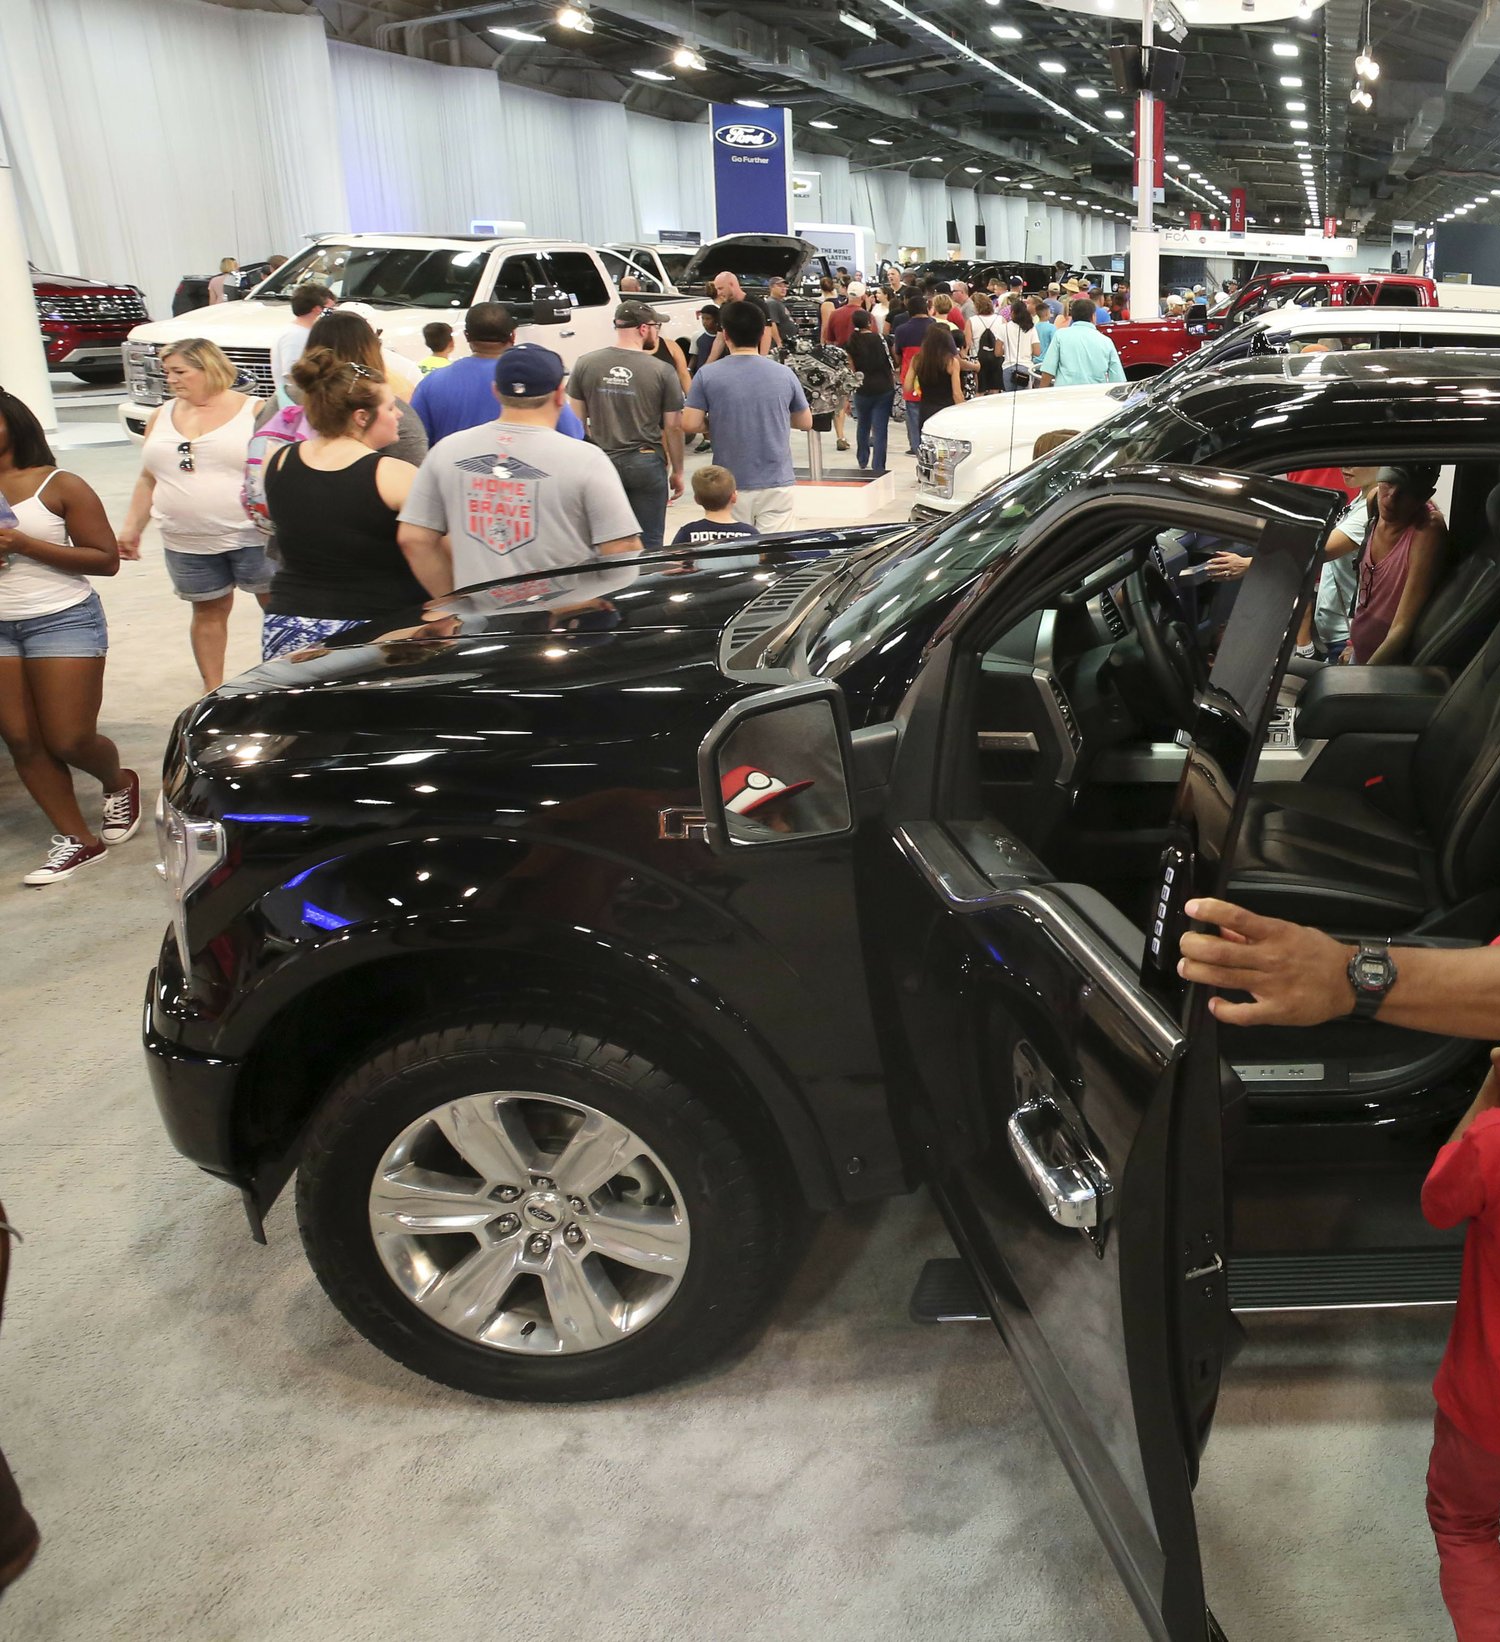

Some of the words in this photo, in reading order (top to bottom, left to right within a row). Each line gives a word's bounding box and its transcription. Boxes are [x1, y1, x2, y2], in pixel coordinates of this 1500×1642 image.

[725, 127, 765, 145] Ford
[731, 155, 743, 163] Go
[743, 155, 770, 165] Further
[1165, 232, 1189, 242] FCA
[472, 479, 526, 496] HOME
[468, 499, 531, 519] BRAVE
